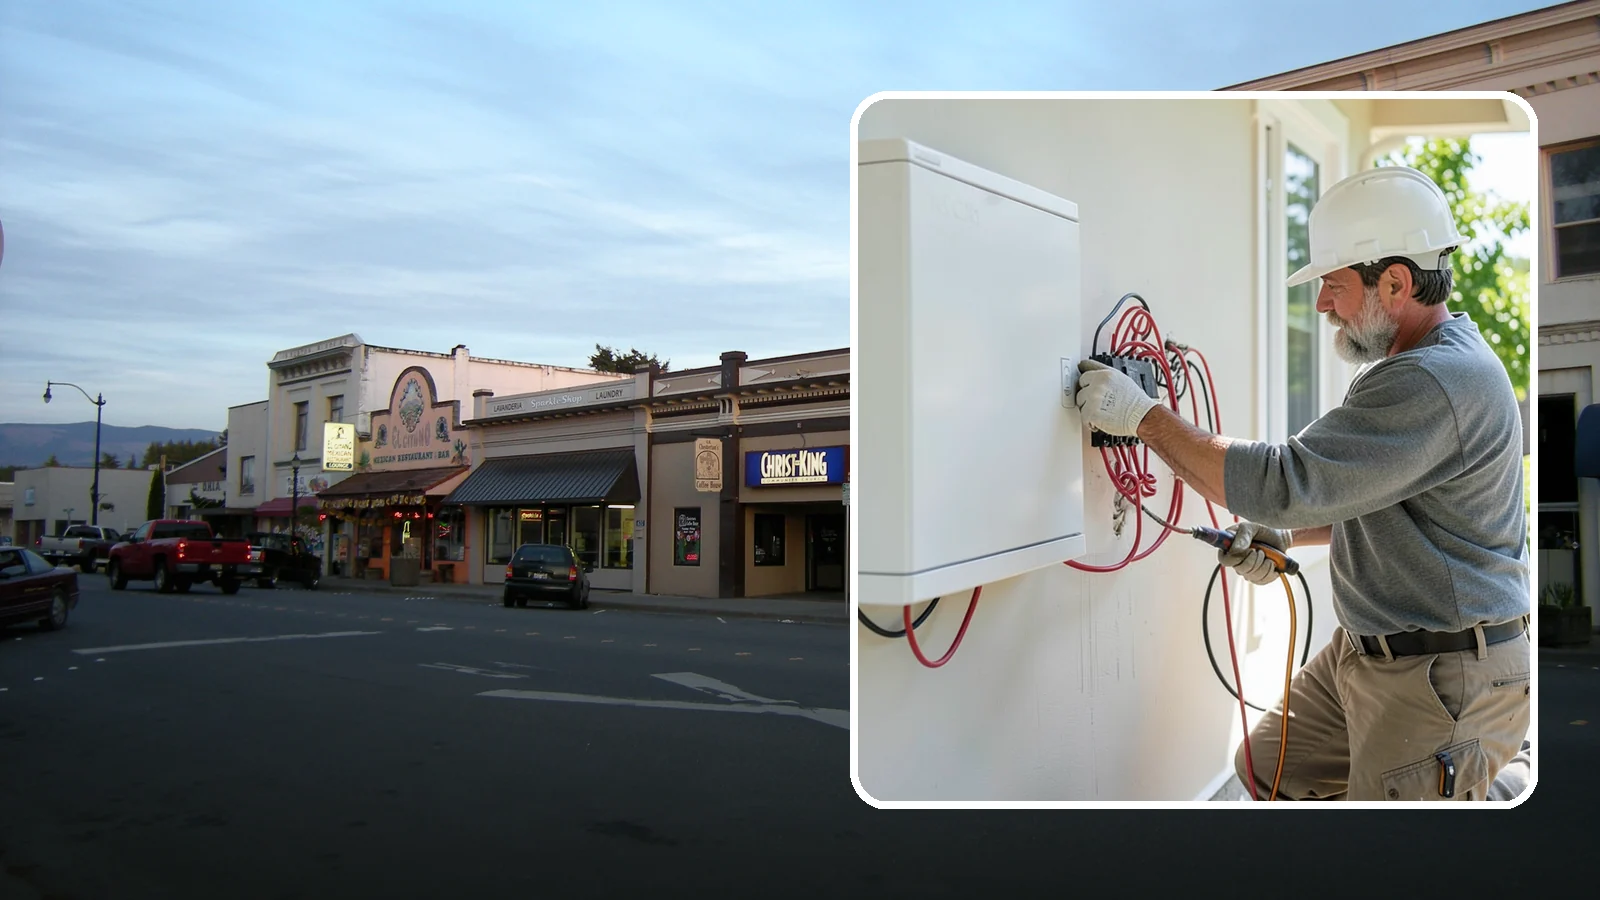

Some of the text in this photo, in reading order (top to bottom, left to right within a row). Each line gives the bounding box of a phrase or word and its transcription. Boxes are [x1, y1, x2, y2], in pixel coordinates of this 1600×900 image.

[595, 388, 624, 400] LAUNDRY
[493, 402, 523, 413] LAVANDERIA
[531, 394, 583, 409] Sparkle Shop
[398, 451, 433, 462] RESTAURANT
[438, 450, 450, 459] BAR
[761, 450, 827, 478] CHRIST KING
